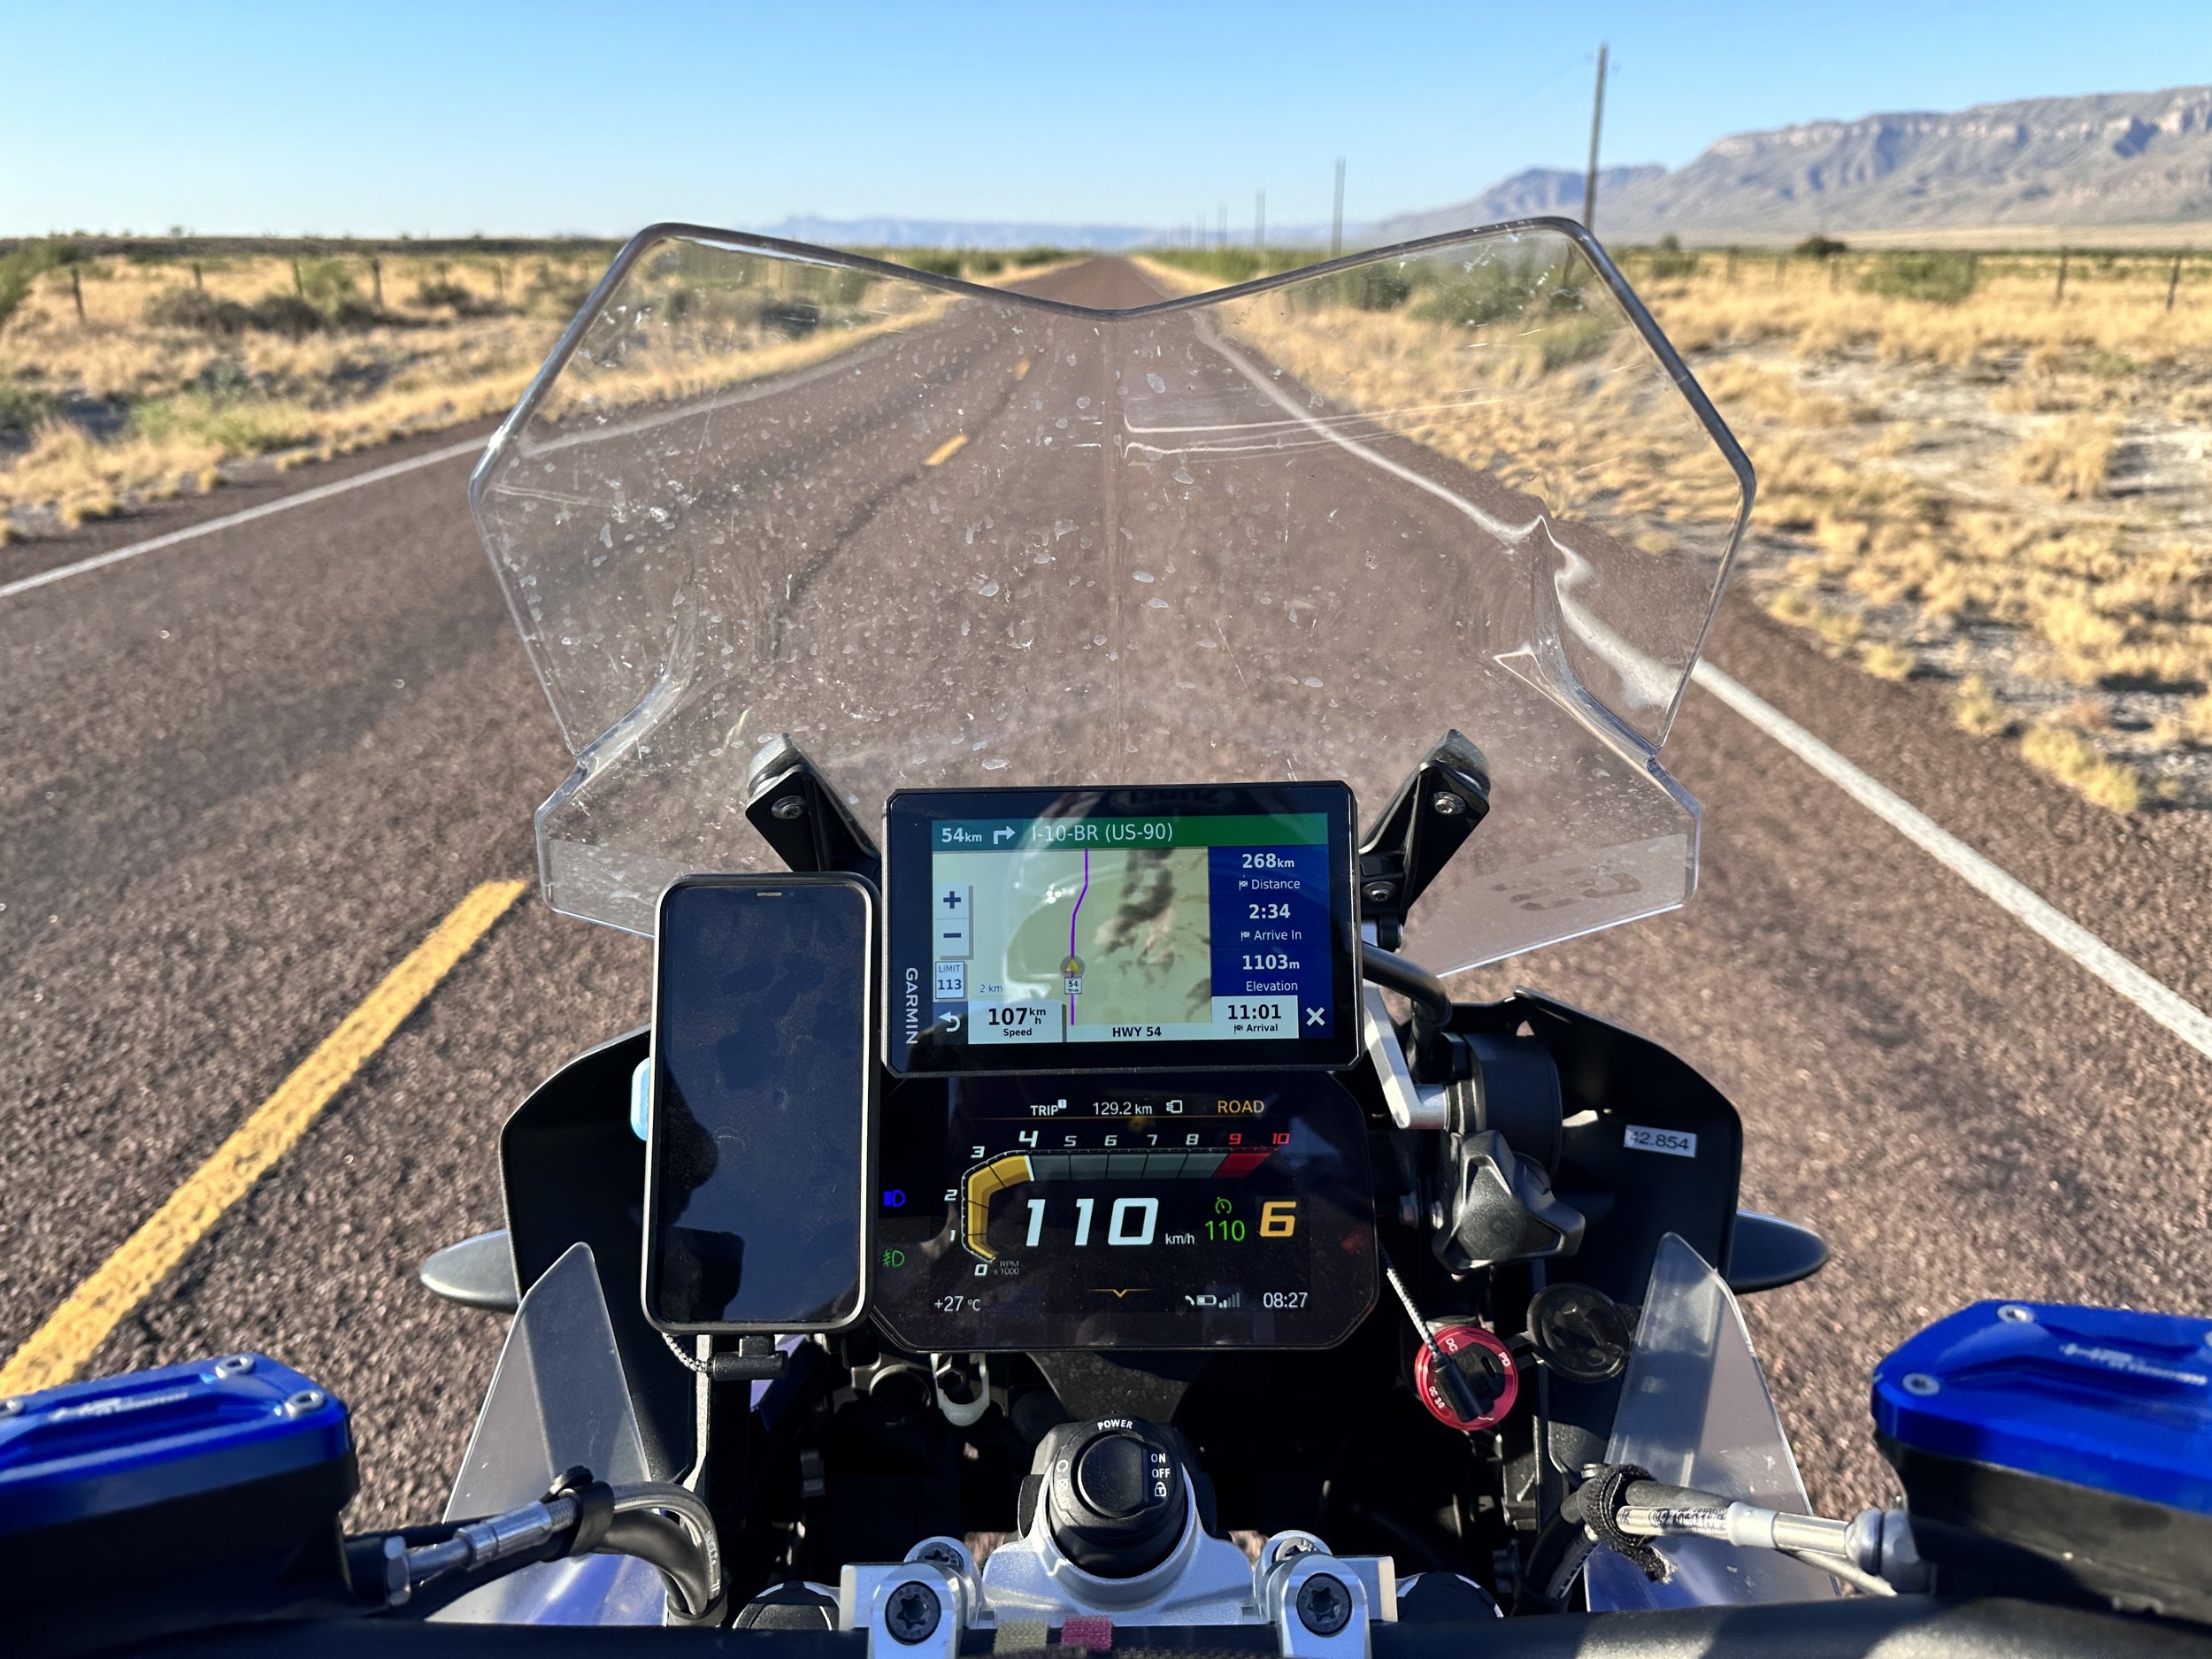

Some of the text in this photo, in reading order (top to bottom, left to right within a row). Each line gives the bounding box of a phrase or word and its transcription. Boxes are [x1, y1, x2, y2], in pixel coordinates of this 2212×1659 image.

[1032, 822, 1173, 842] I-10-BR (US-90)
[1251, 879, 1301, 890] Distance
[1248, 903, 1291, 919] 2:34
[1254, 929, 1302, 941] Arrive In
[938, 964, 962, 973] LIMIT
[938, 979, 962, 990] 113
[979, 984, 1003, 993] 2 km
[1246, 980, 1298, 992] Elevation
[905, 967, 918, 1044] GARMIN
[1227, 1003, 1282, 1020] 11:01
[988, 1007, 1028, 1025] 107
[1002, 1028, 1033, 1039] Speed
[1112, 1026, 1162, 1038] HWY 54
[1246, 1024, 1279, 1033] Arrival
[1030, 1105, 1059, 1116] TRIP
[1093, 1102, 1132, 1116] 129.2
[1134, 1102, 1153, 1115] km
[1217, 1100, 1264, 1114] ROAD
[1018, 1131, 1291, 1148] 4 5 6 7 8 9 10
[971, 1146, 985, 1158] 3
[944, 1189, 958, 1201] 2
[1025, 1197, 1194, 1247] 110 km/h
[1259, 1201, 1297, 1237] 6
[949, 1230, 956, 1241] 1
[1204, 1219, 1246, 1241] 110
[974, 1263, 988, 1276] 0
[1001, 1267, 1019, 1276] 1000
[934, 1295, 964, 1311] +27
[1263, 1292, 1309, 1309] 08:27
[1445, 1337, 1458, 1352] DC
[1498, 1351, 1511, 1367] PD
[1097, 1418, 1133, 1431] POWER
[1150, 1453, 1166, 1463] ON
[1151, 1468, 1171, 1479] OFF
